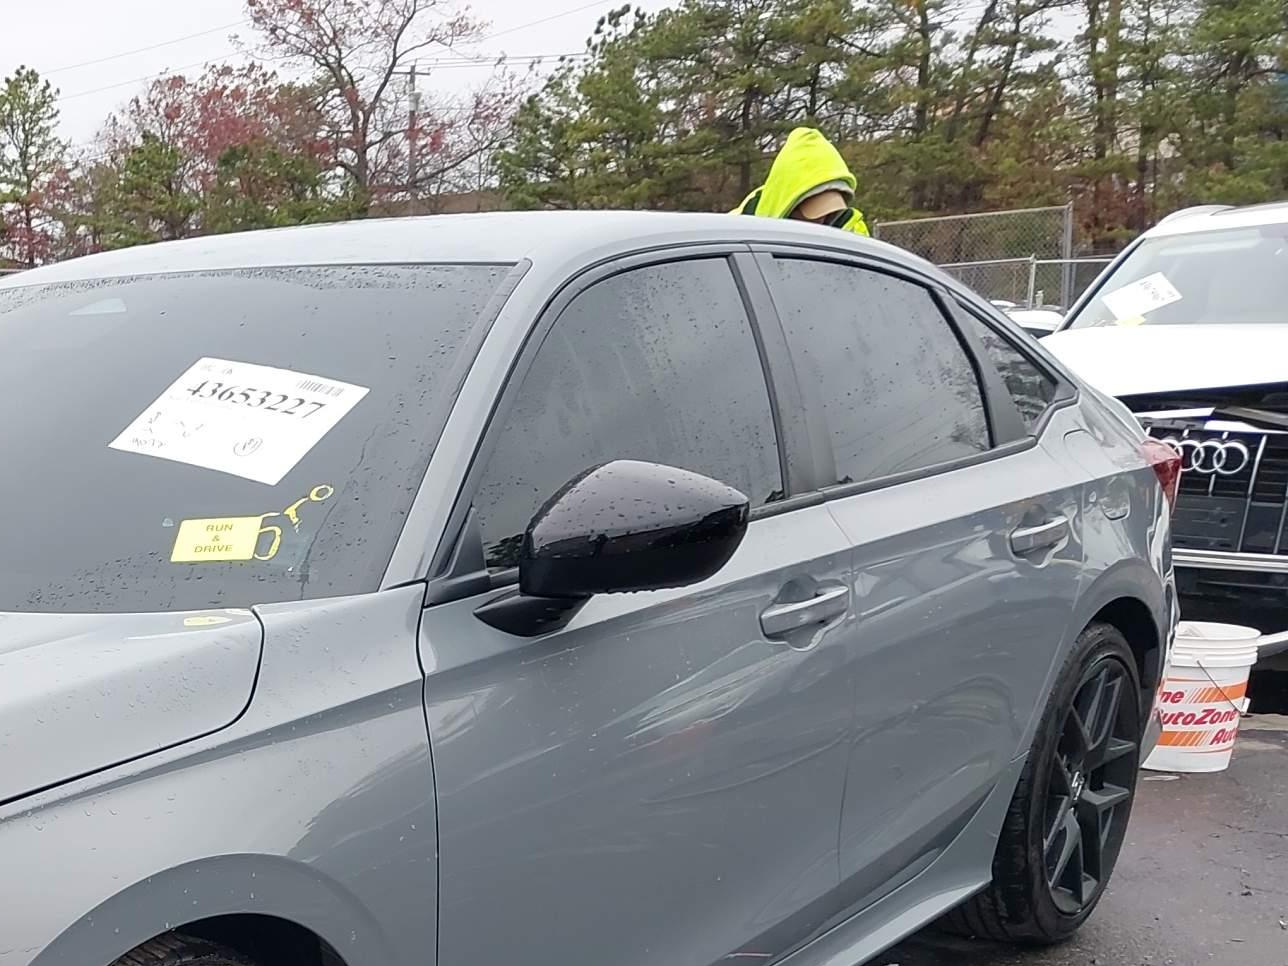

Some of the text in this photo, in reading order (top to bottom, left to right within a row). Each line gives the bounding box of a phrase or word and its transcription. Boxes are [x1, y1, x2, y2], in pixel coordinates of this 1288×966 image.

[186, 379, 326, 419] 43653227
[206, 523, 234, 532] RUN
[194, 544, 233, 553] DRIVE
[1160, 708, 1237, 726] utoZone
